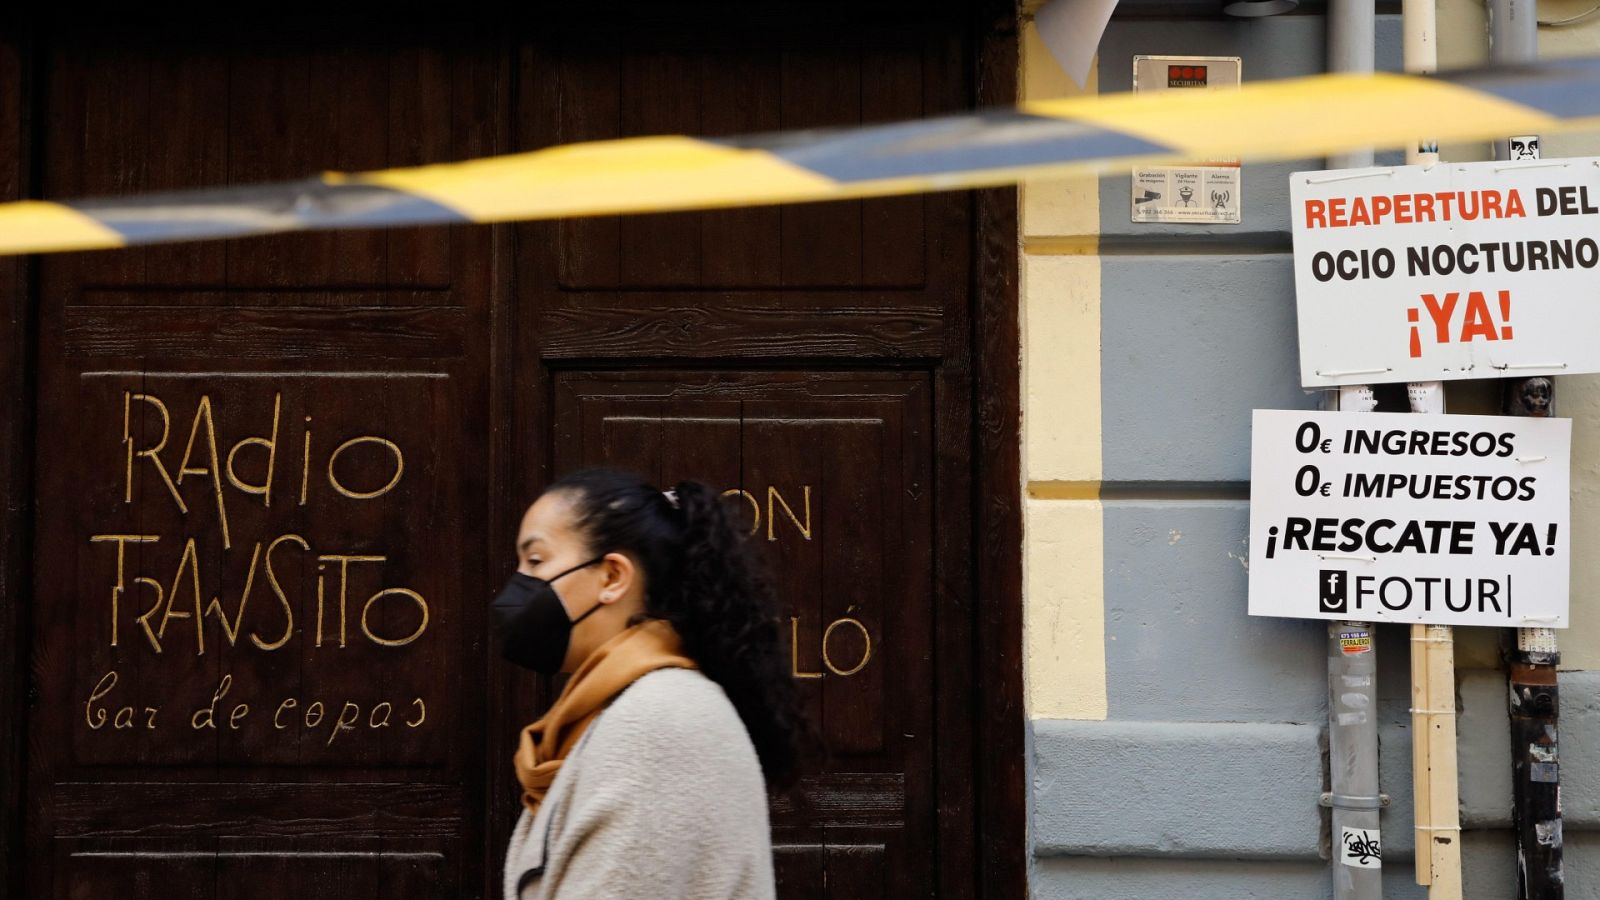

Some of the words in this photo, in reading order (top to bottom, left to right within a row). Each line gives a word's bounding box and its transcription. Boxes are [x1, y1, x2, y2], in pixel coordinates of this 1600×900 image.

[1305, 189, 1526, 228] REAPERTURA
[1536, 185, 1599, 217] DEL
[1312, 248, 1395, 282] OCIO
[1406, 238, 1599, 276] NOCTURNO
[1407, 290, 1513, 358] ¡YA!
[1295, 422, 1332, 453] 0€
[1343, 430, 1516, 457] INGRESOS
[1295, 465, 1332, 496] 0€
[1343, 473, 1536, 501] IMPUESTOS
[720, 485, 812, 541] ON
[1265, 517, 1475, 559] ¡RESCATE
[1488, 522, 1558, 556] YA!
[791, 605, 871, 678] LÓ
[86, 671, 158, 729] bar
[192, 674, 249, 729] de
[274, 698, 426, 745] copas
